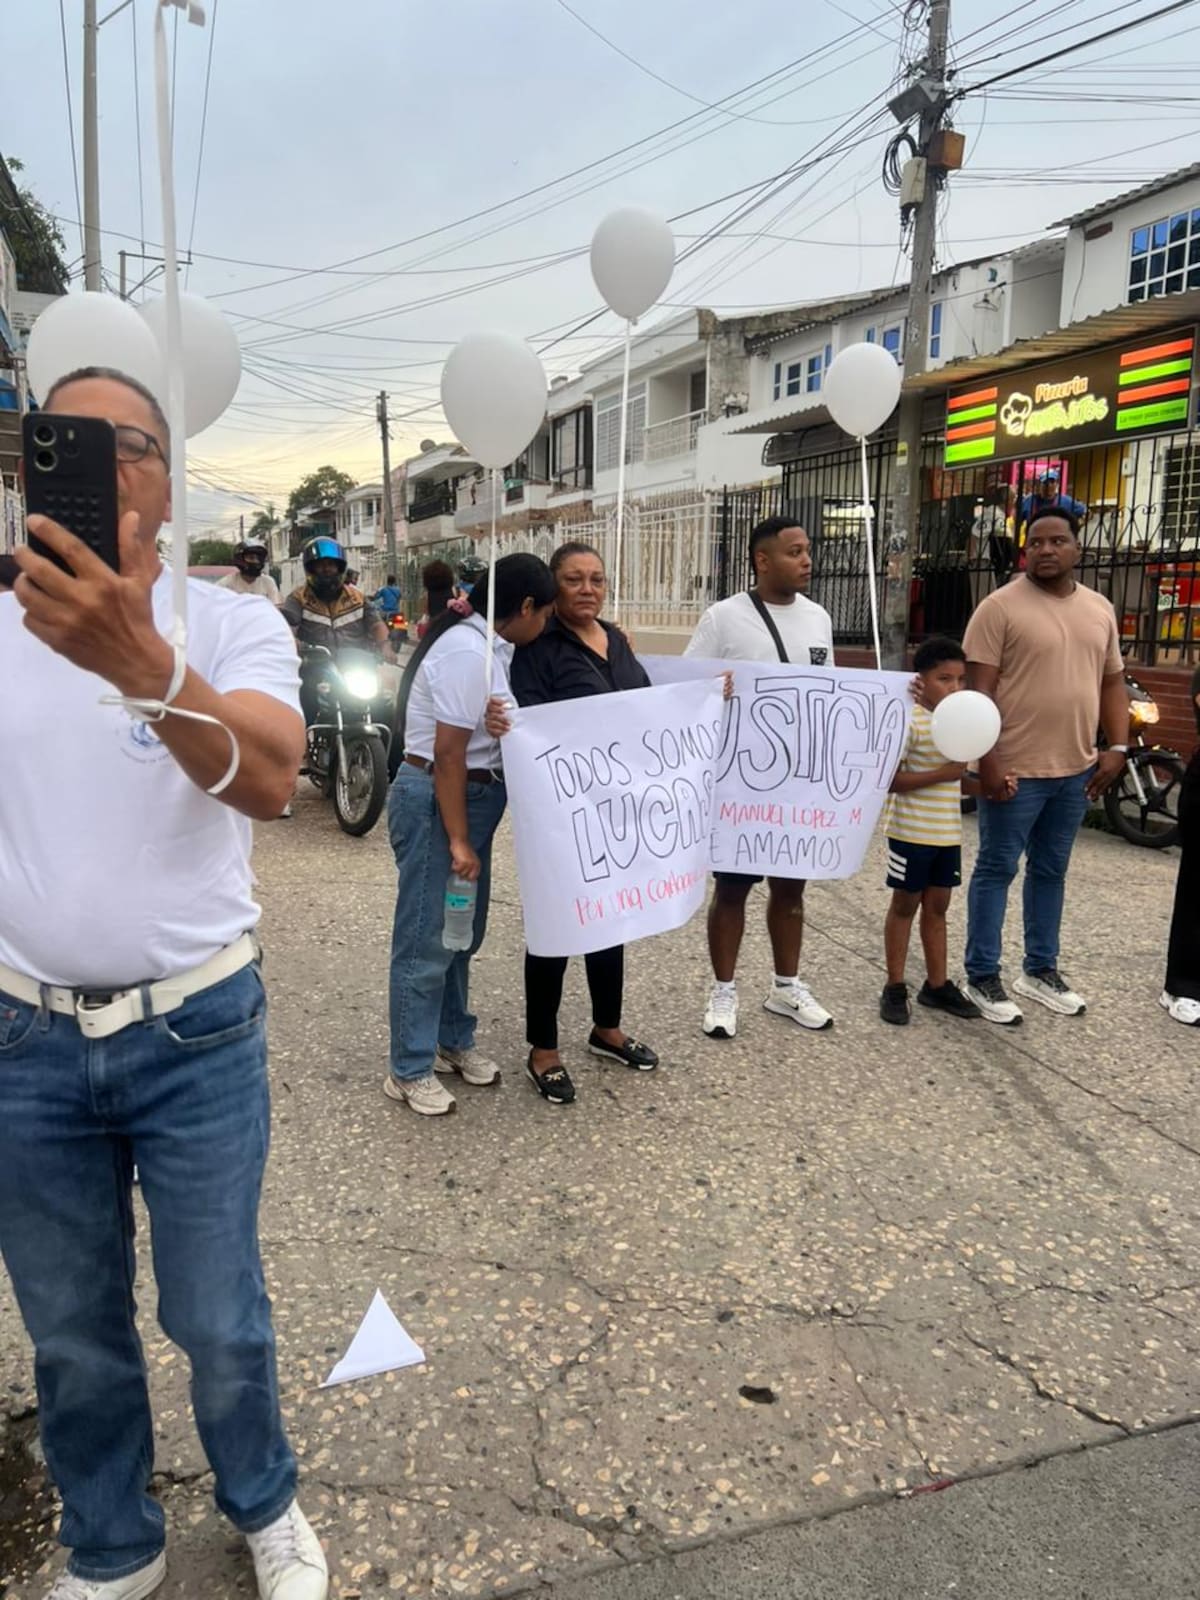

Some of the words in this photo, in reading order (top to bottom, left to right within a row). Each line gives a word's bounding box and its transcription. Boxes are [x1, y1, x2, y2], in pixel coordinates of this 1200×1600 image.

[535, 742, 632, 803] TODOS
[719, 801, 784, 827] MANUEL
[735, 830, 846, 871] AMAMOS
